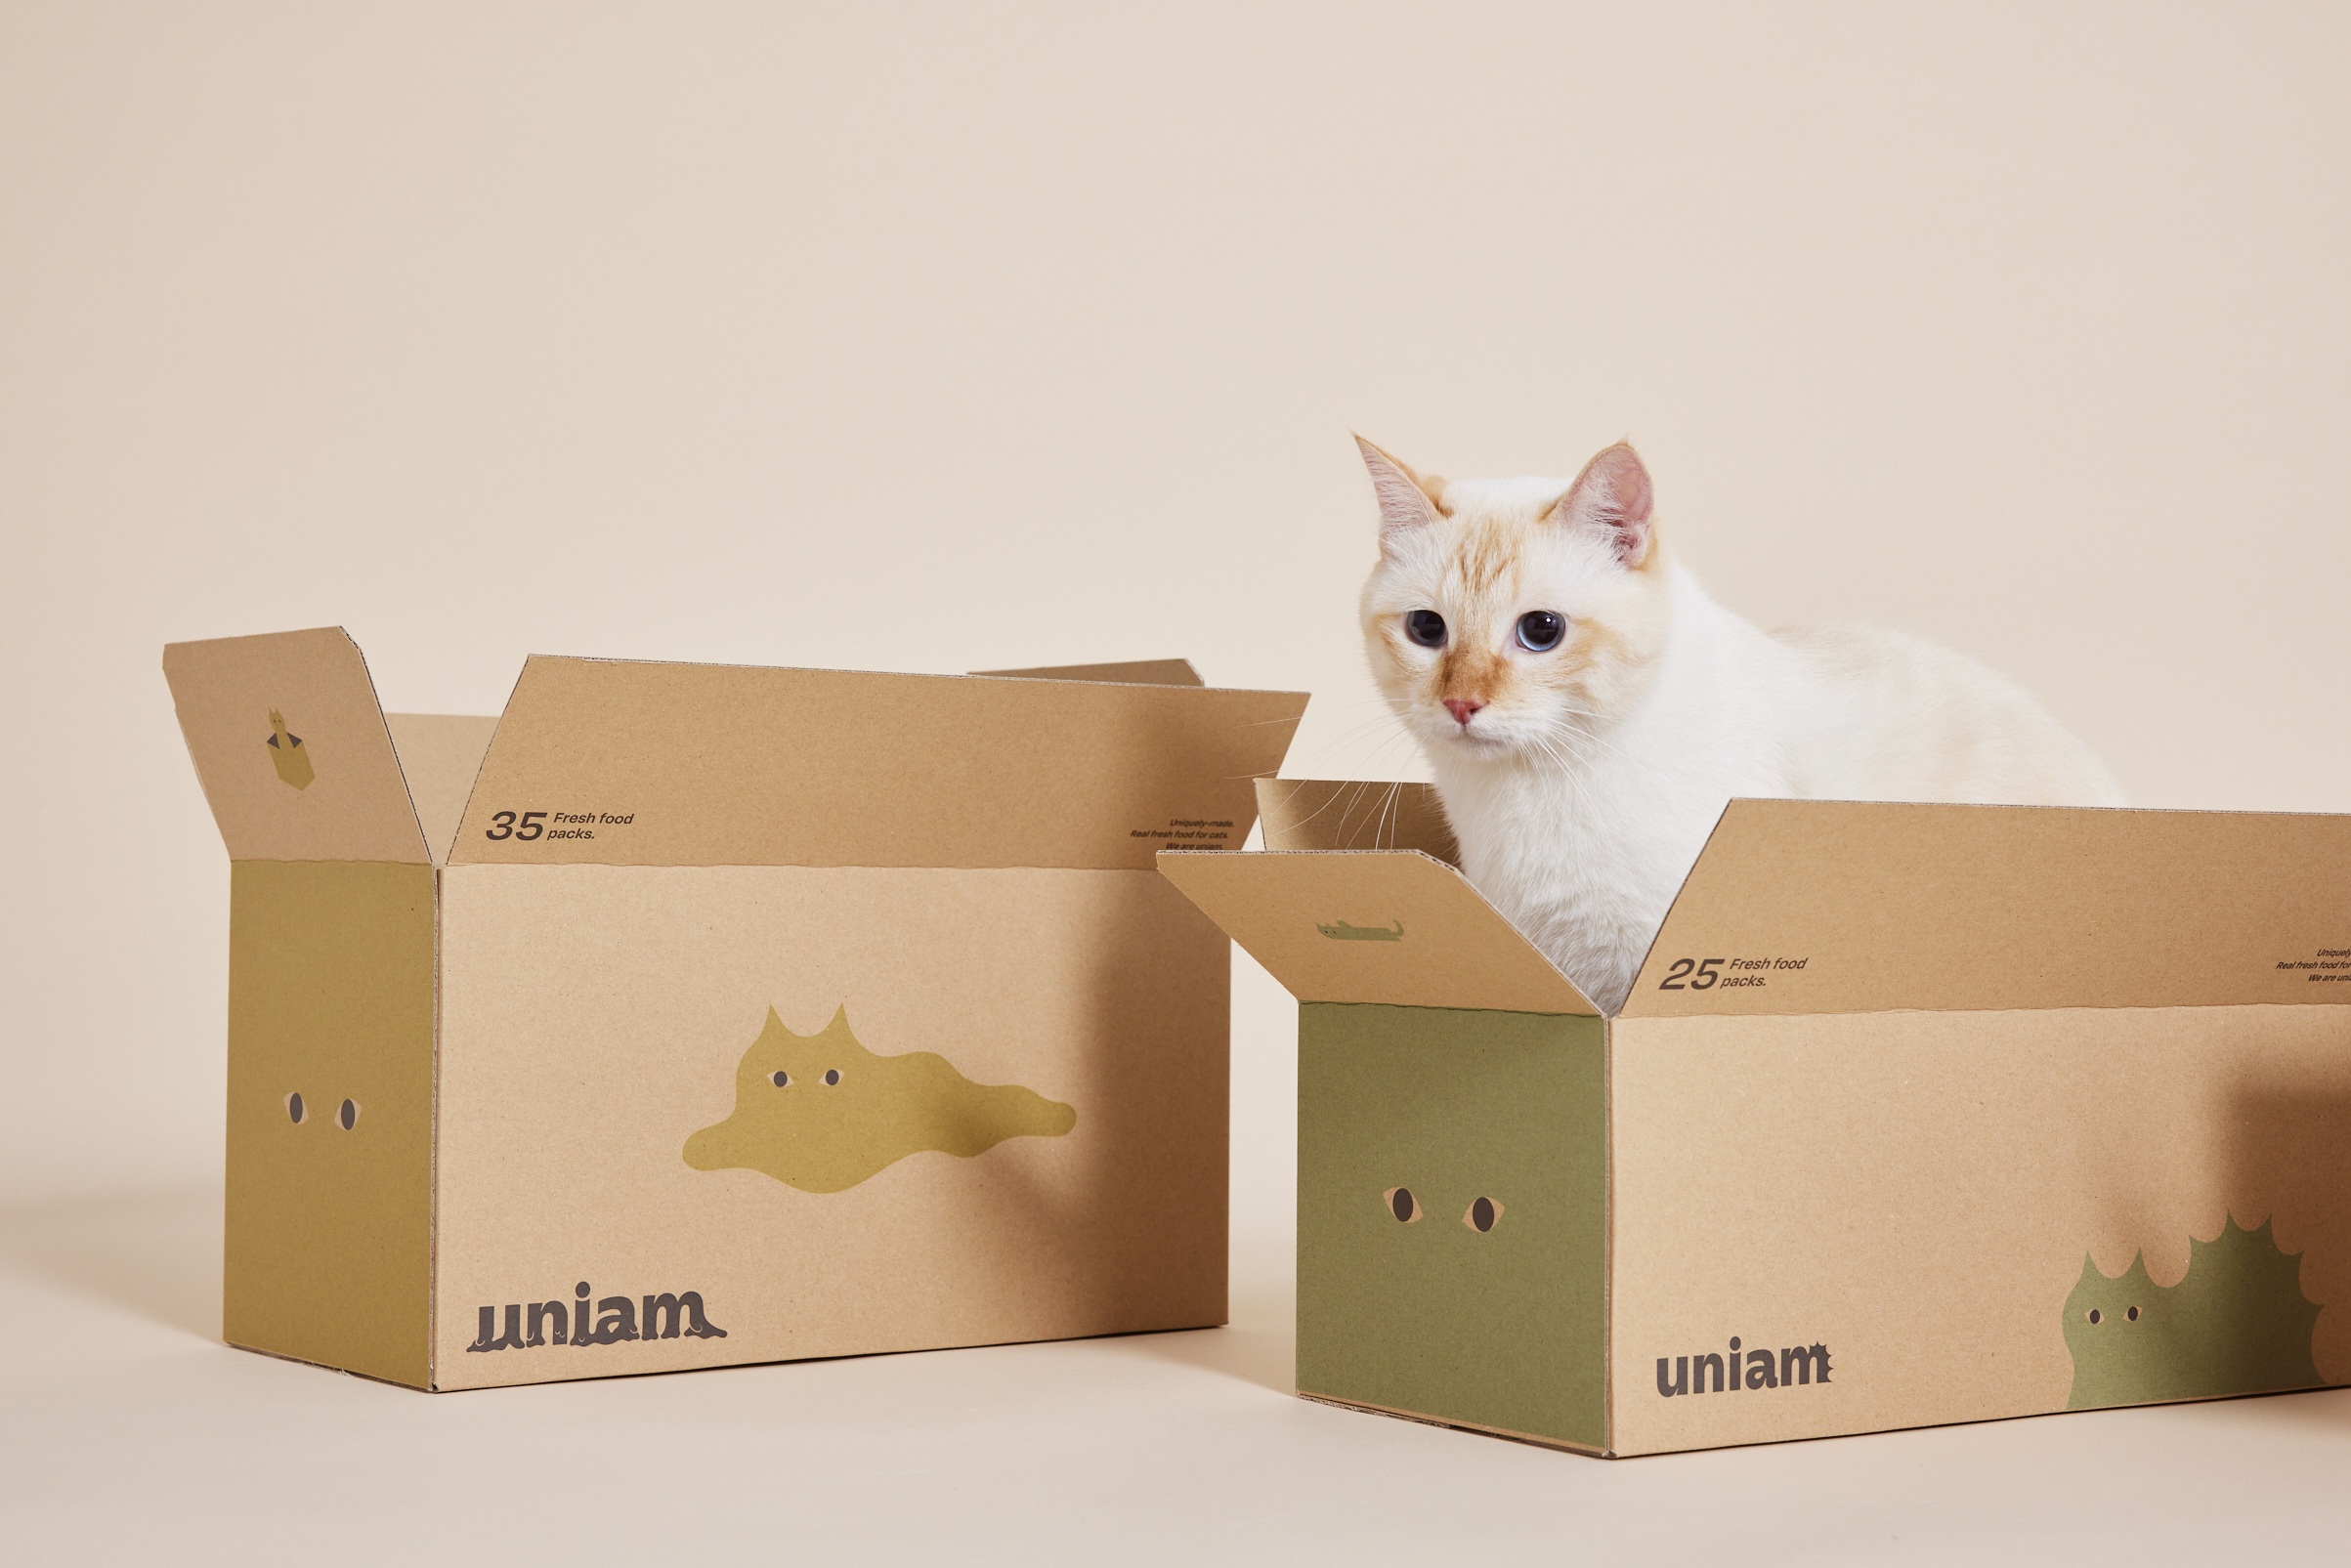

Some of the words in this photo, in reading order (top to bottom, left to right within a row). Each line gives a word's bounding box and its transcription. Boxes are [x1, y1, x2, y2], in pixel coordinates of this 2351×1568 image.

[553, 812, 596, 824] Fresh
[599, 813, 635, 825] food
[1170, 819, 1234, 828] Uniquely-made.
[486, 811, 548, 841] 35
[546, 827, 595, 841] packs.
[1130, 829, 1150, 838] Real
[1150, 829, 1173, 838] fresh
[1174, 829, 1195, 839] food
[1195, 830, 1208, 839] for
[1729, 957, 1771, 970] Fresh
[1773, 956, 1809, 970] food
[2276, 960, 2296, 970] Real
[2295, 960, 2319, 970] fresh
[2319, 960, 2340, 970] food
[2338, 960, 2351, 970] for
[1658, 957, 1726, 991] 25
[2308, 973, 2323, 982] We
[1720, 974, 1767, 990] packs.
[465, 1281, 728, 1353] uniam
[1656, 1335, 1835, 1398] uniam
